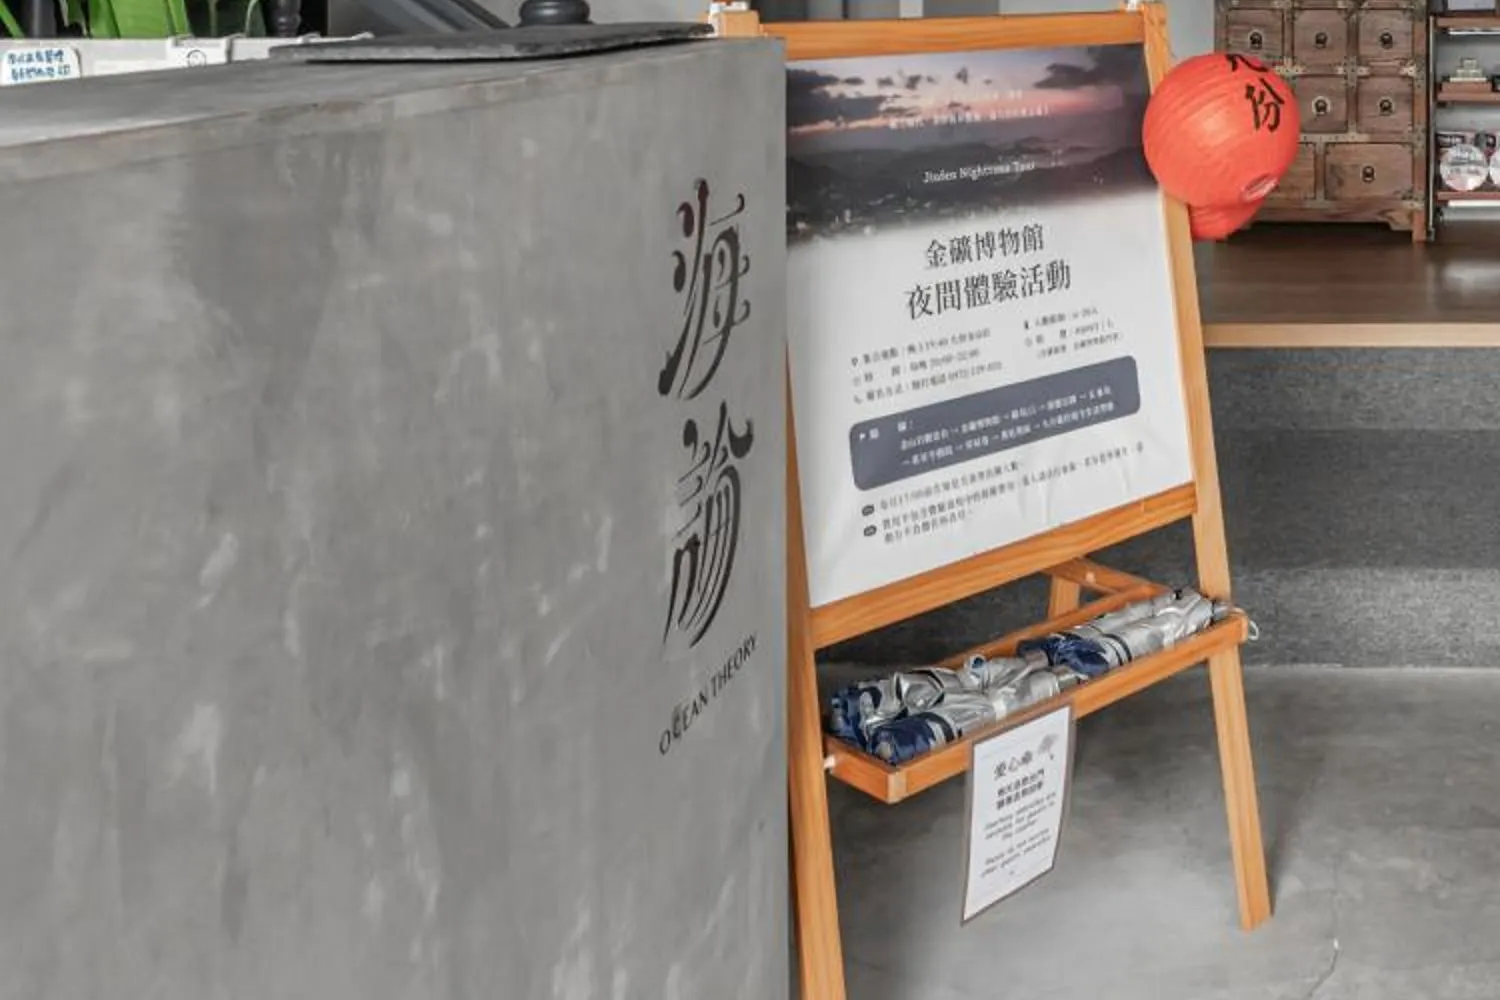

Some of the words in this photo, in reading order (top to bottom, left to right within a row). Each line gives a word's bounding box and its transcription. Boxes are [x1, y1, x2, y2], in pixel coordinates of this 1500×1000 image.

[925, 223, 1044, 269] 金礦博物館
[907, 258, 1071, 320] 夜間體驗活動
[659, 684, 709, 756] OCEAN
[710, 632, 757, 697] THEORY
